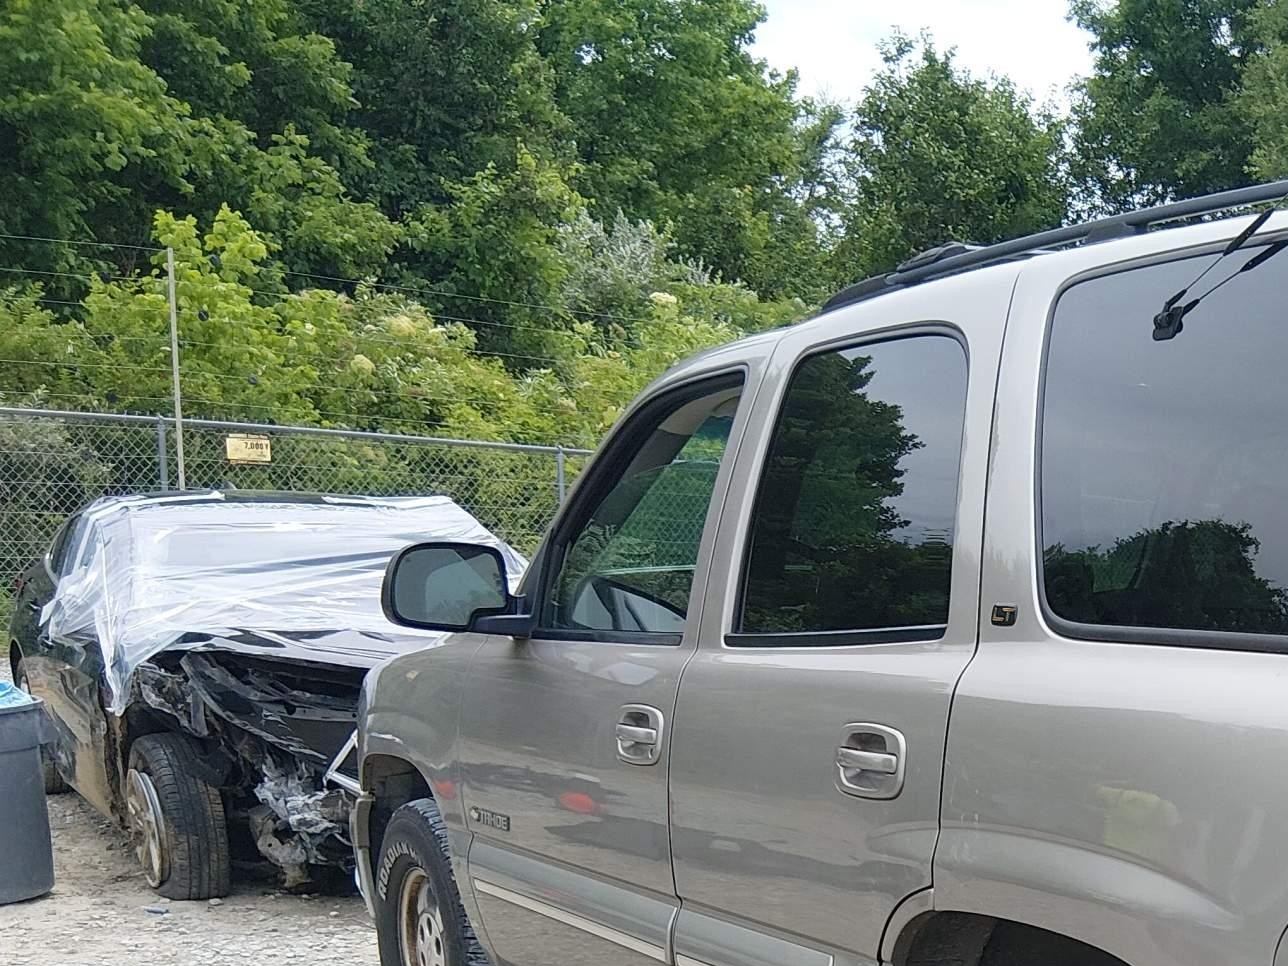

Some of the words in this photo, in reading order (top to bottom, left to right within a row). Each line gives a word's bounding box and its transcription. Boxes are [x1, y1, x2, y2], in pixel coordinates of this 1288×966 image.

[992, 607, 1017, 622] LT
[480, 809, 509, 831] TAHOE
[378, 840, 410, 901] ROADIAN
